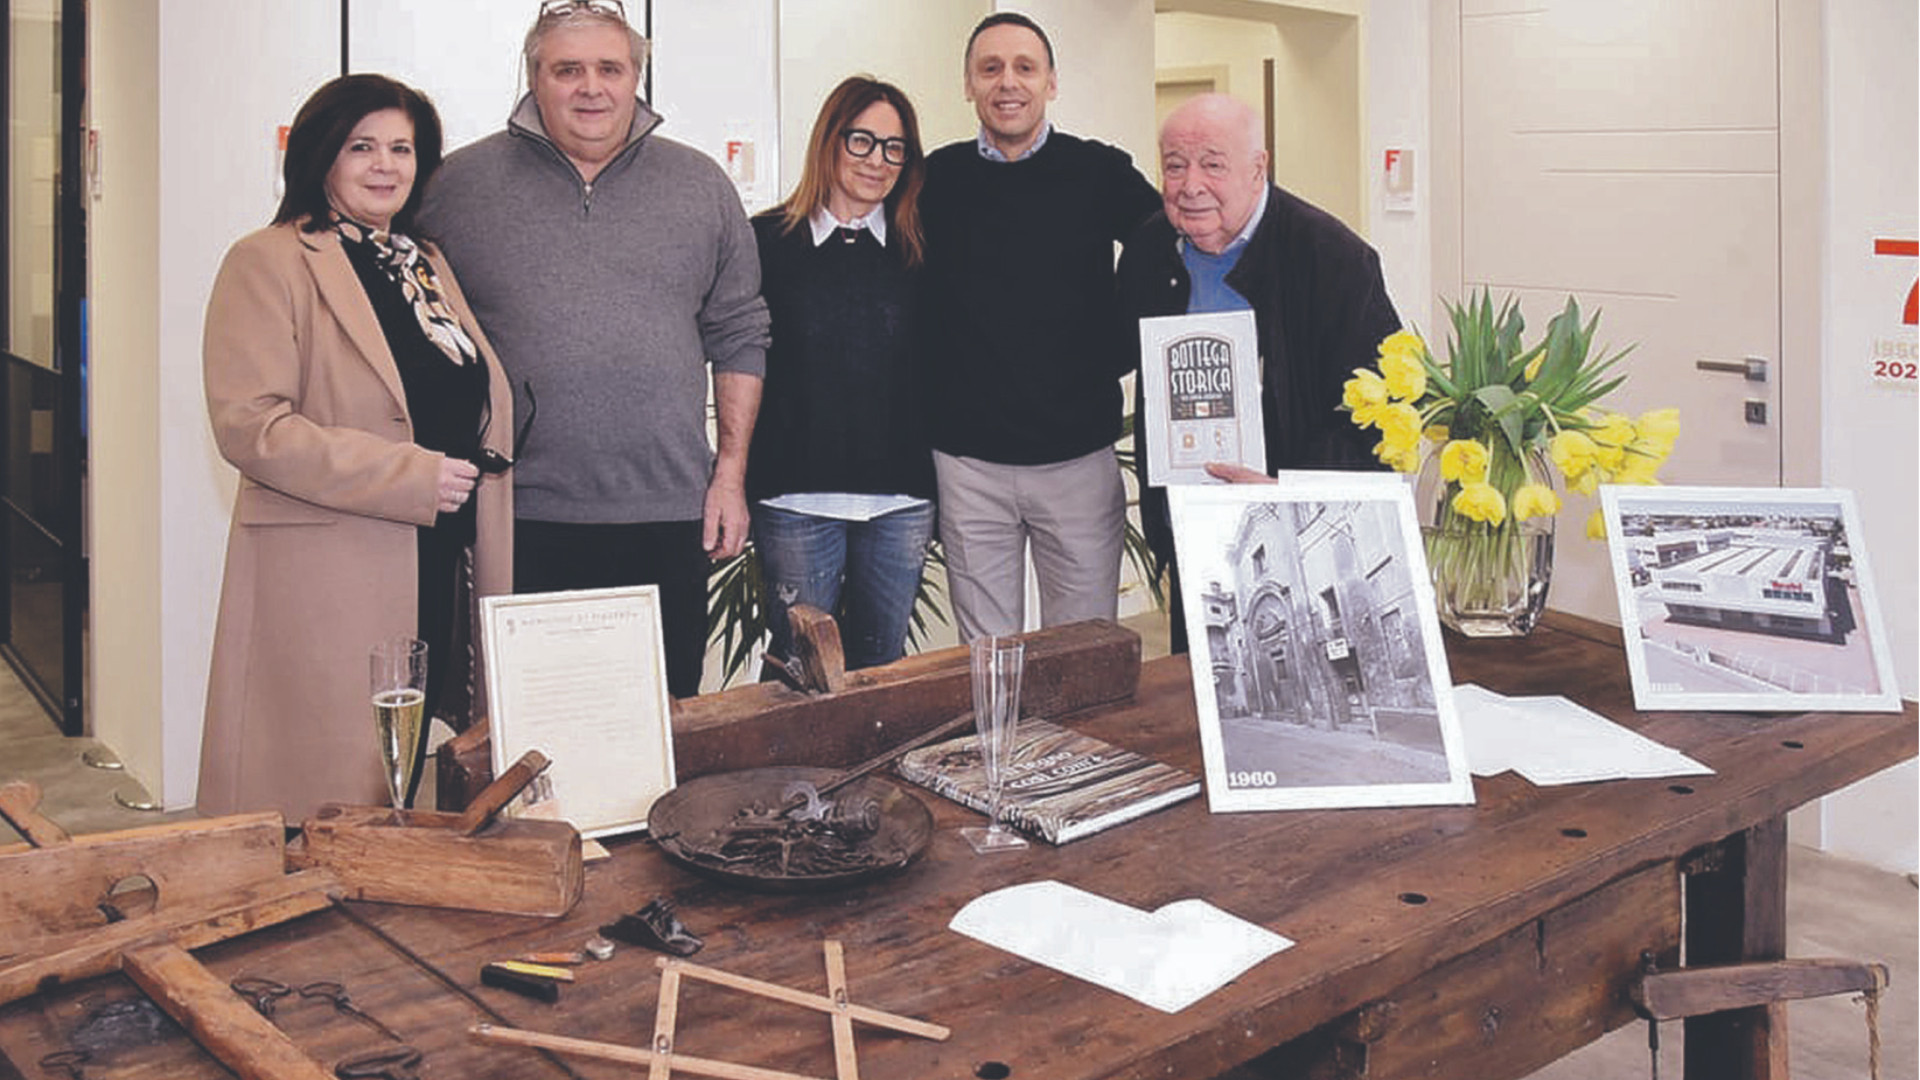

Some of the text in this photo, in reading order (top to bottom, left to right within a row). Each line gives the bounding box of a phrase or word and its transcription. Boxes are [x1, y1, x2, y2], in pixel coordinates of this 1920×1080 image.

[727, 141, 742, 162] F
[1385, 149, 1401, 171] F
[1171, 340, 1229, 368] BOTTEGA
[1171, 369, 1231, 394] STORICA
[1229, 770, 1277, 787] 1960
